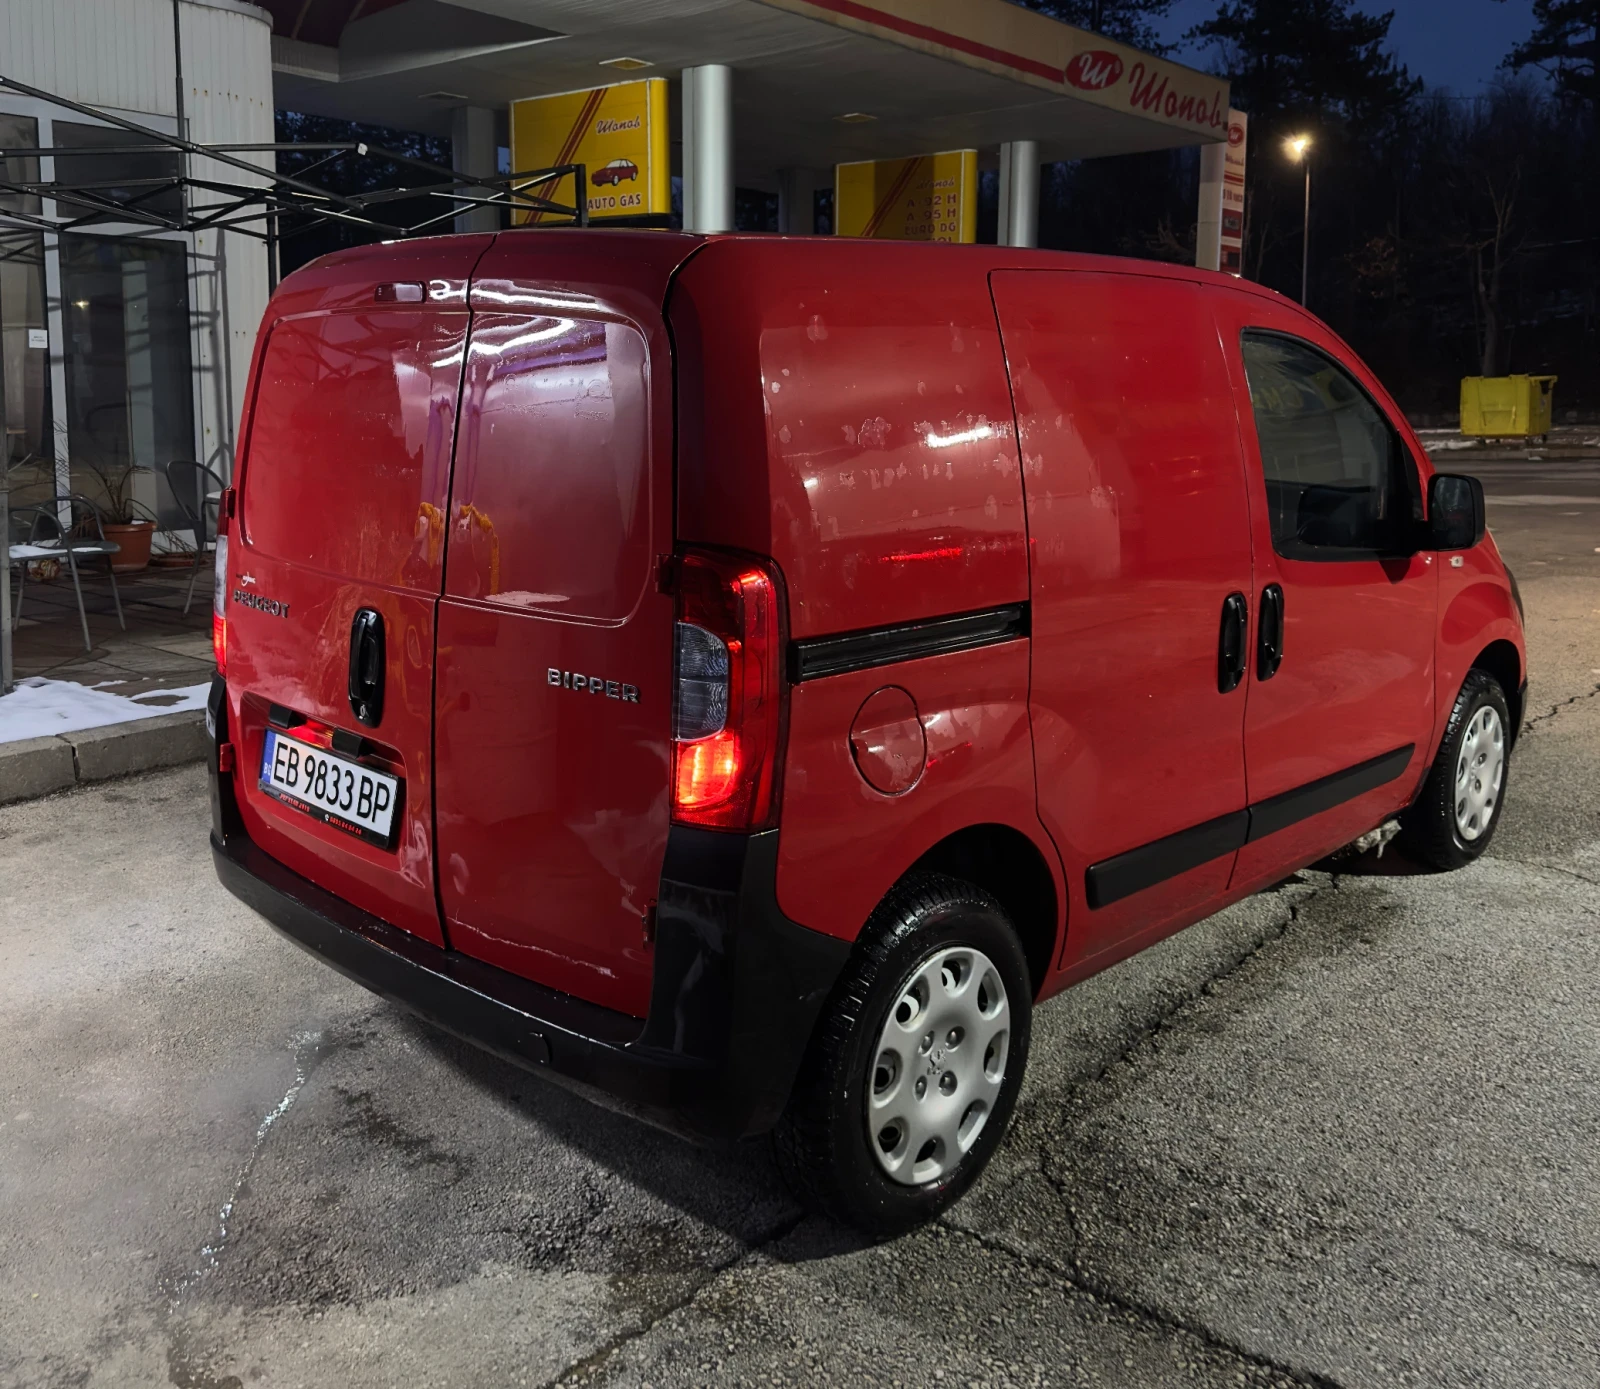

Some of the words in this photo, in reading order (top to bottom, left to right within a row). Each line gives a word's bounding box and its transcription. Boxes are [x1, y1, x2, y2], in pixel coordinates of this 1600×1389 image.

[587, 196, 616, 211] AUTO
[619, 193, 642, 208] GAS
[924, 209, 941, 221] 95
[234, 589, 290, 618] PEUGEOT
[547, 667, 639, 703] BIPPER
[263, 762, 272, 776] BG
[273, 741, 300, 788] EB
[303, 755, 354, 811] 9833
[356, 775, 390, 823] BP
